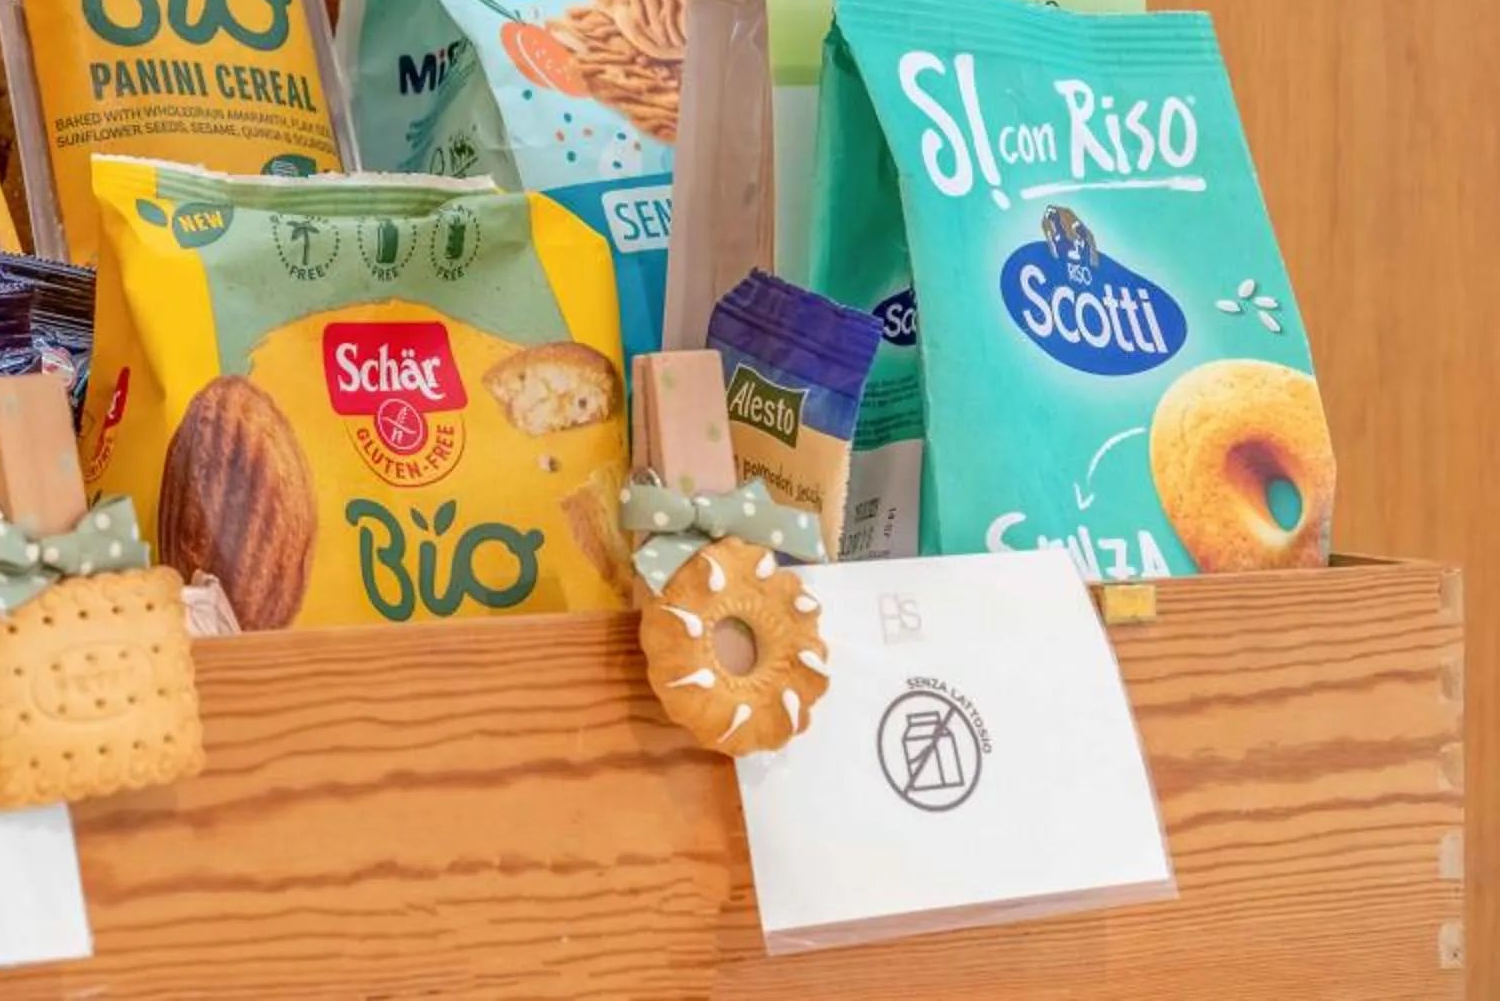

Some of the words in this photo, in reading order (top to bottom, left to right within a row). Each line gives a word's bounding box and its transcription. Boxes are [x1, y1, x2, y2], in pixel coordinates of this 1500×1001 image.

[89, 57, 209, 101] PANINI
[214, 62, 318, 113] CEREAL
[54, 112, 102, 132] BAKED
[103, 107, 142, 122] WITH
[56, 123, 144, 148] SUNFLOWER
[998, 118, 1056, 164] con
[178, 210, 225, 234] NEW
[288, 265, 327, 282] FREE
[371, 266, 402, 282] FREE
[435, 265, 466, 282] FREE
[1019, 263, 1170, 354] Scotti
[335, 342, 447, 401] Schär
[729, 380, 796, 436] Alesto
[356, 423, 456, 480] GLUTEN-FREE
[906, 676, 948, 693] SENZA
[950, 687, 993, 755] LATTOSIO
